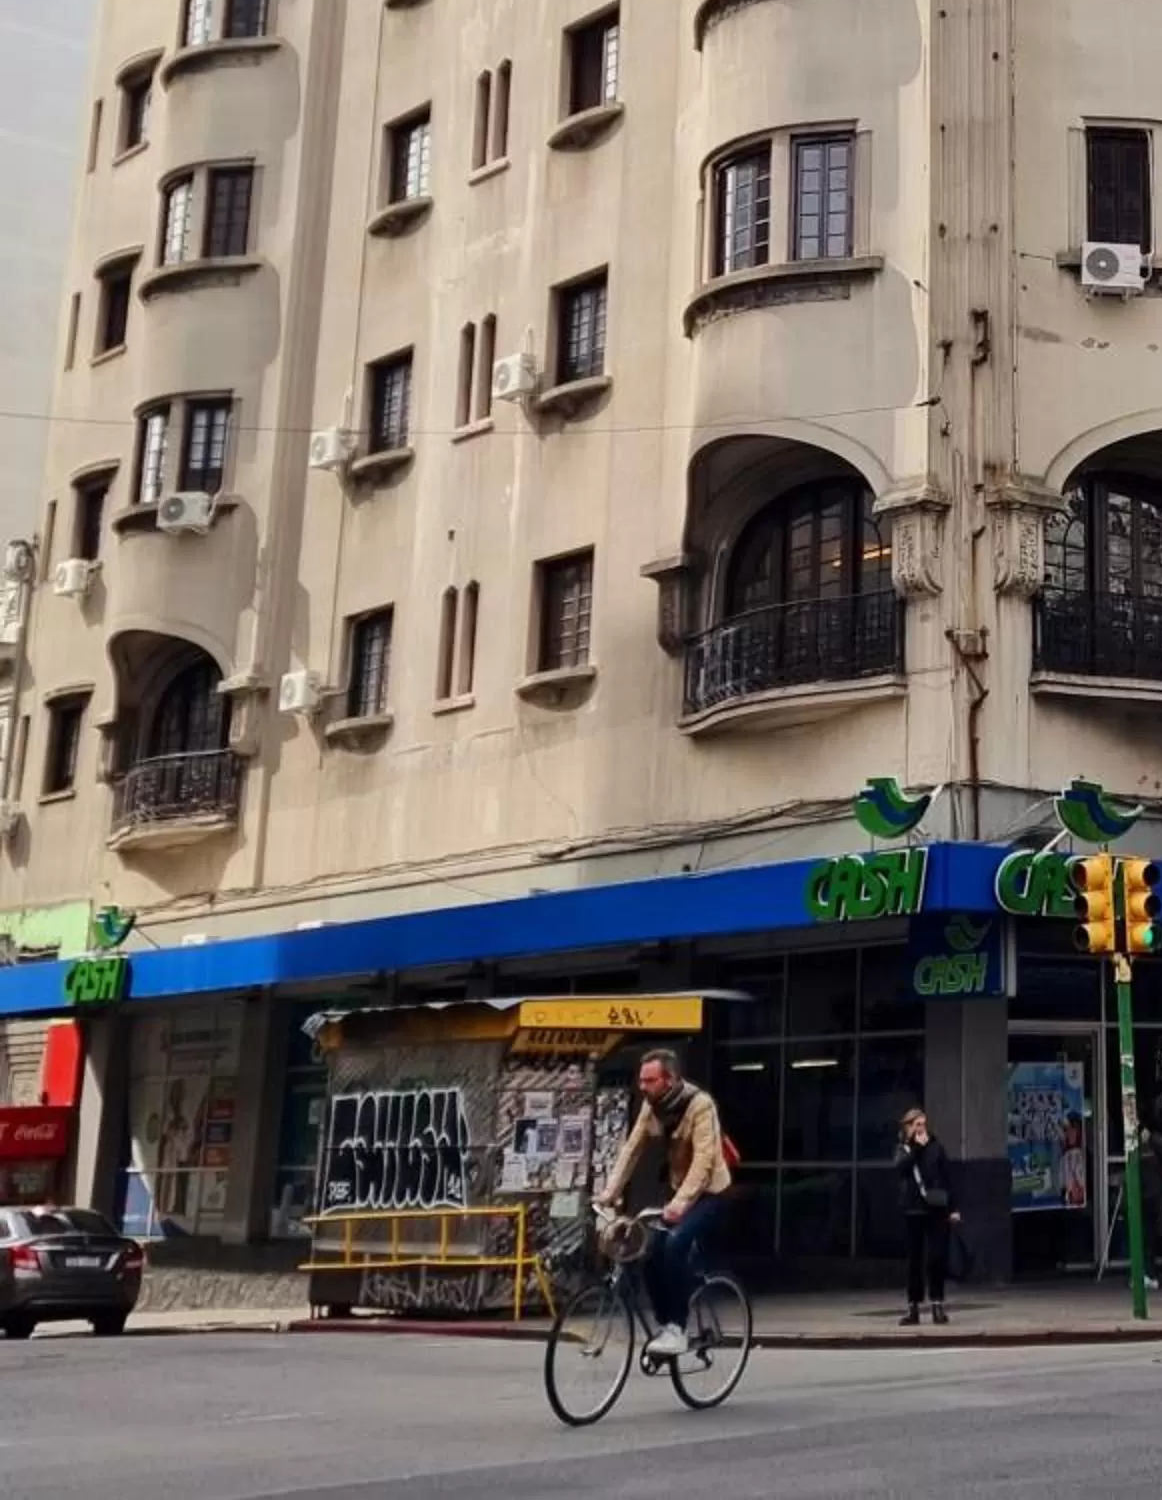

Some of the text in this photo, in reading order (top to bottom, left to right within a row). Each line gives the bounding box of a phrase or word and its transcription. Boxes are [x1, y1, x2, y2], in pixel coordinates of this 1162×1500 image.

[805, 847, 928, 921] CASH
[63, 958, 126, 1002] CASH
[913, 953, 988, 995] CASH
